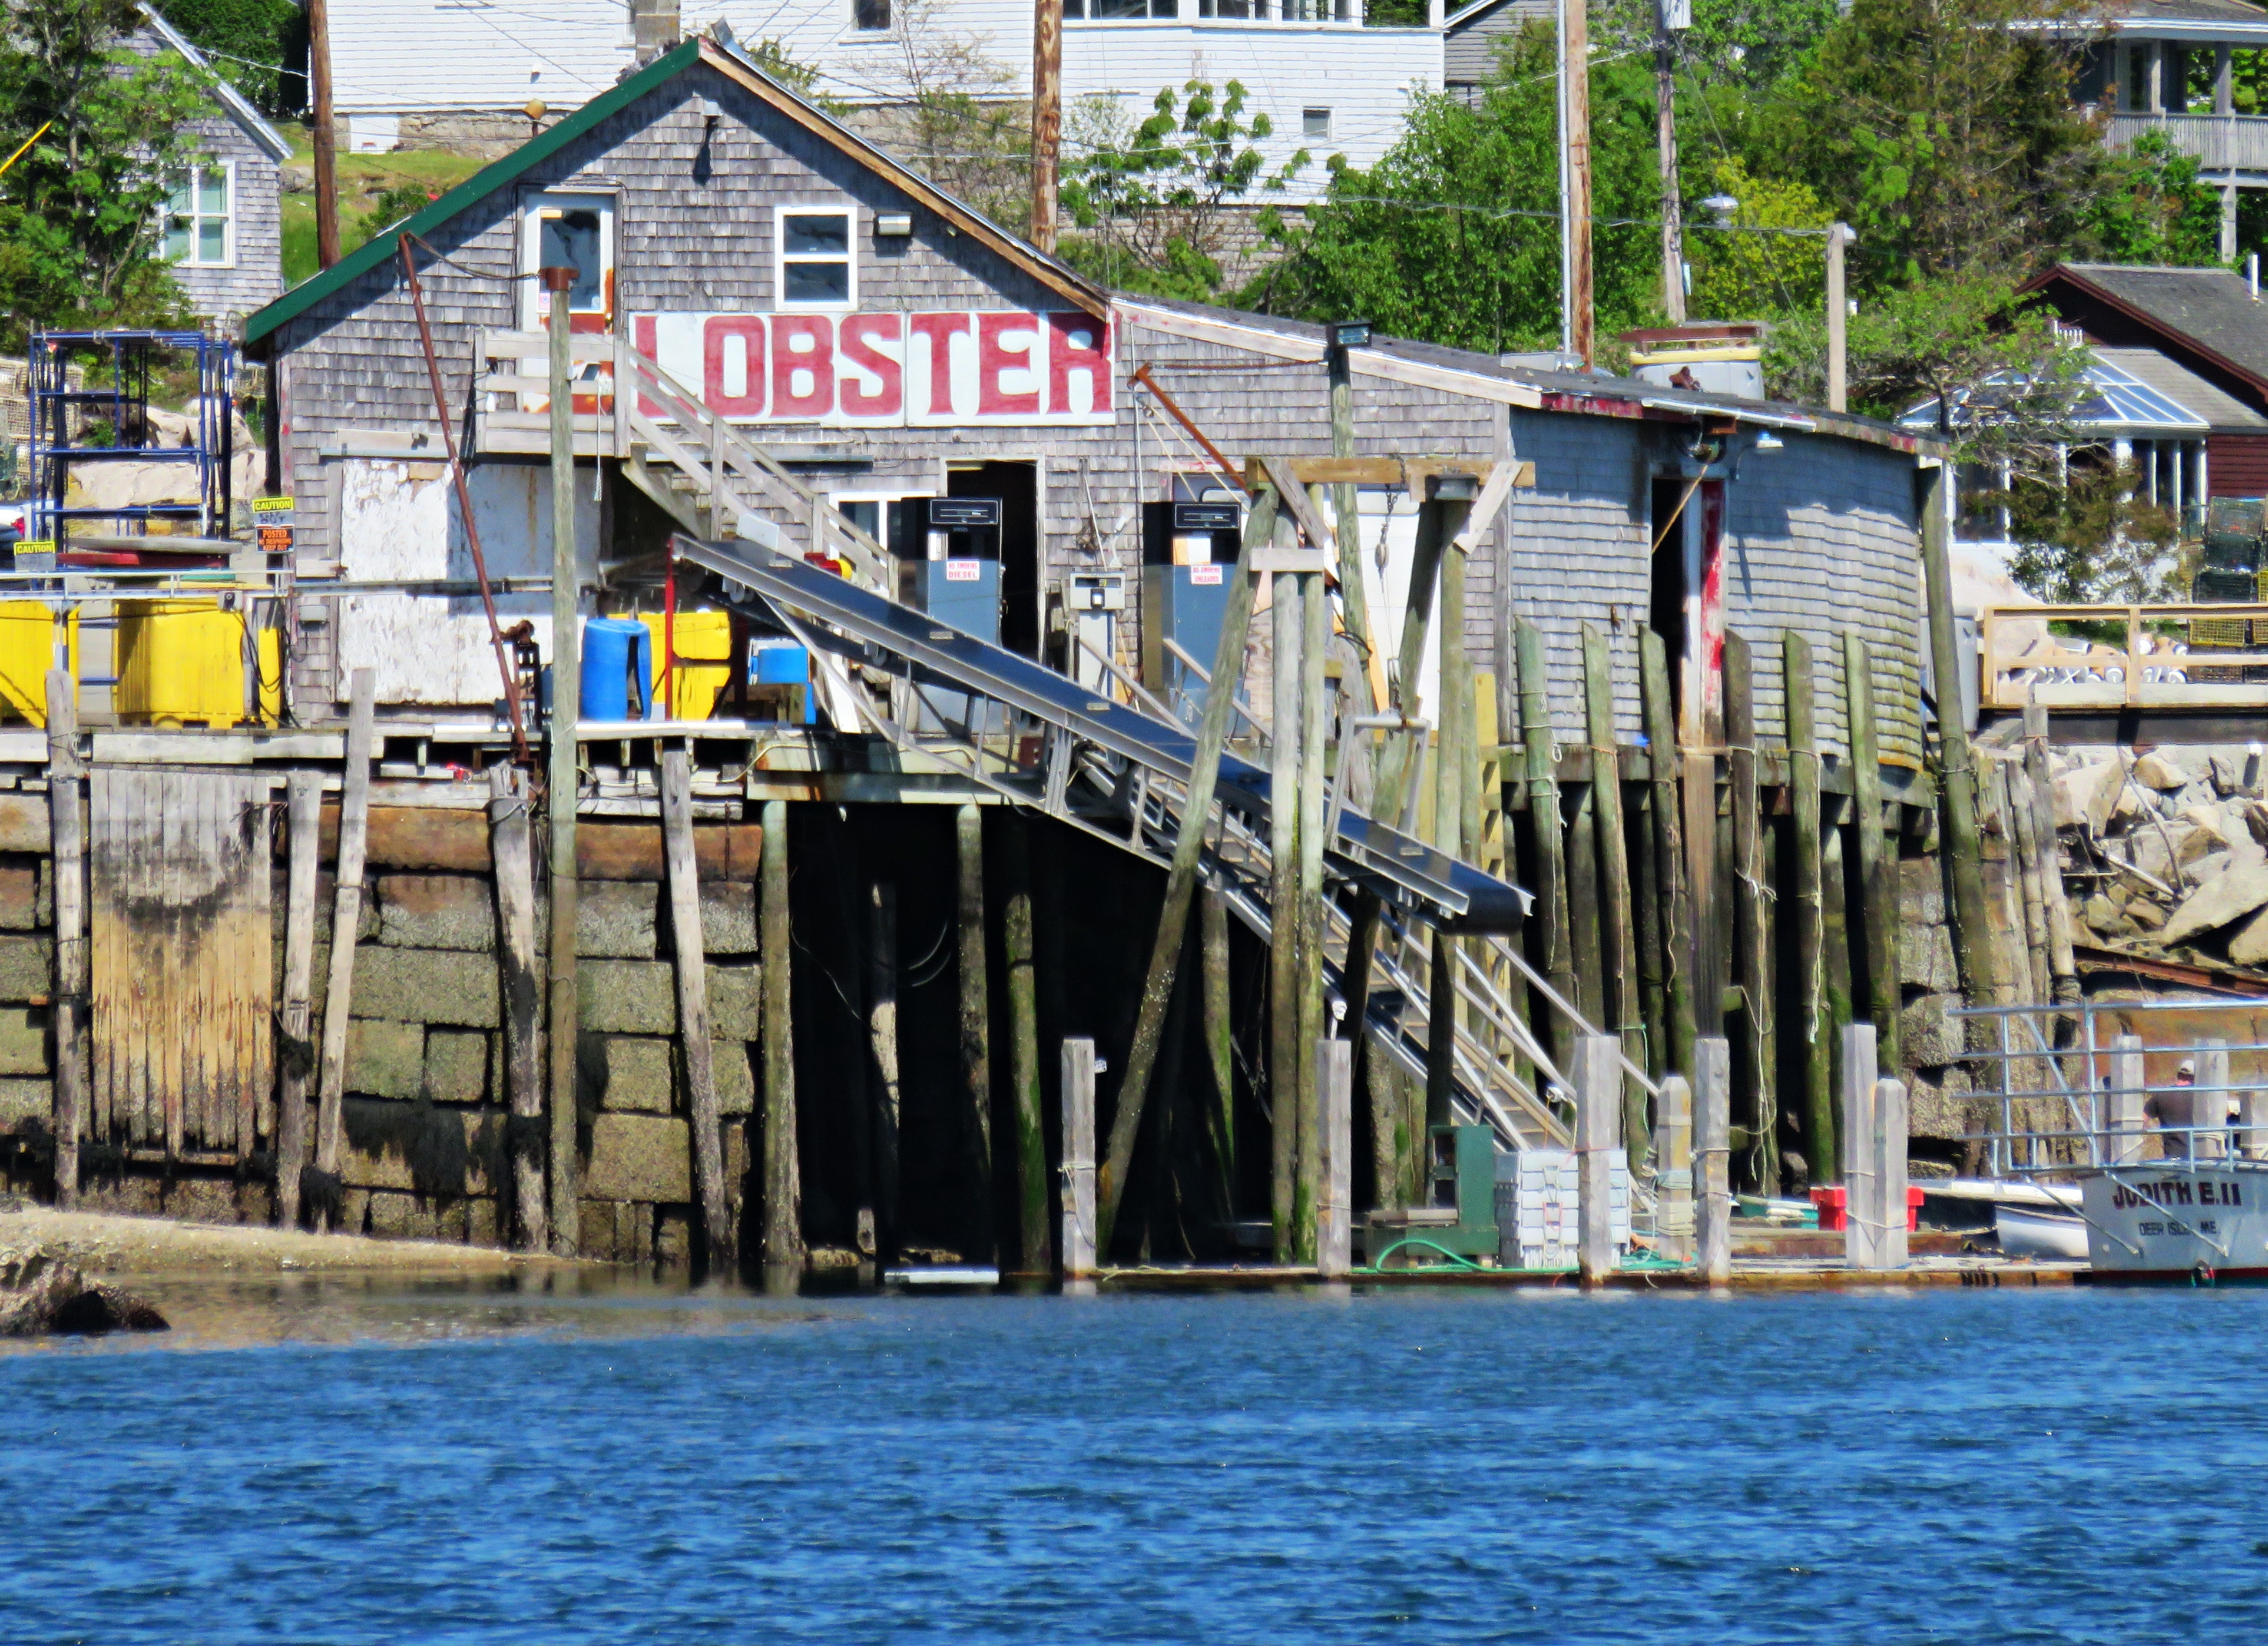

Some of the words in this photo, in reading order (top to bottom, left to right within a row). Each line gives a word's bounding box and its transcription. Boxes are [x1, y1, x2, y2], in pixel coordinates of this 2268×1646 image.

[635, 312, 1113, 418] LOBSTER
[255, 501, 290, 511] CAUTION
[263, 529, 287, 538] POSTED
[17, 544, 52, 554] CAUTION
[2113, 1182, 2193, 1210] JUDITH
